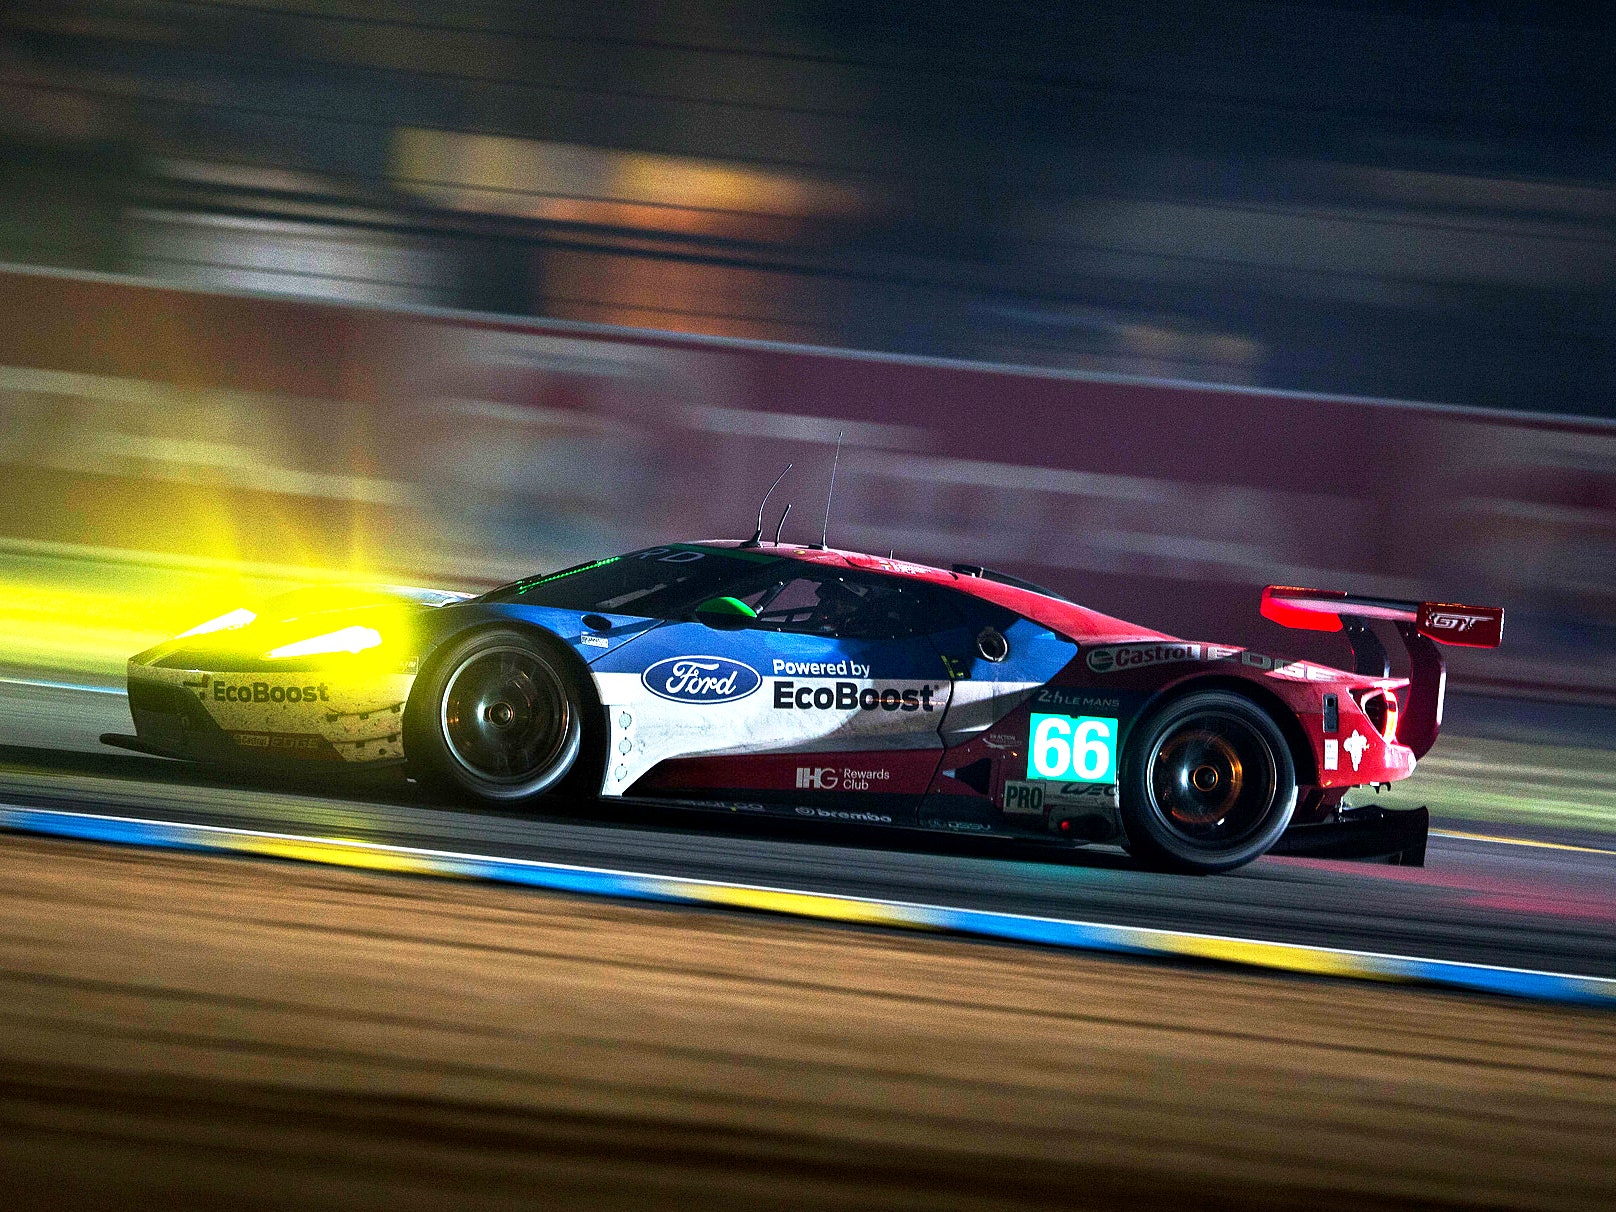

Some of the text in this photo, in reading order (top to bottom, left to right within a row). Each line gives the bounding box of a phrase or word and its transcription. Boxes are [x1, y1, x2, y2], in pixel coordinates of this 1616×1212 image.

[1430, 612, 1494, 632] GT
[1115, 644, 1197, 668] Castrol
[666, 661, 738, 696] Ford
[772, 659, 871, 679] Powered by
[213, 680, 329, 703] EcoBoost
[773, 680, 934, 712] EcoBoost
[1064, 696, 1080, 706] LE
[1082, 697, 1120, 708] MANS
[1033, 717, 1111, 780] 66
[796, 767, 839, 790] IHG
[843, 768, 890, 780] Rewards
[843, 779, 870, 791] Club
[1006, 785, 1044, 809] PRO
[817, 807, 892, 823] brembo
